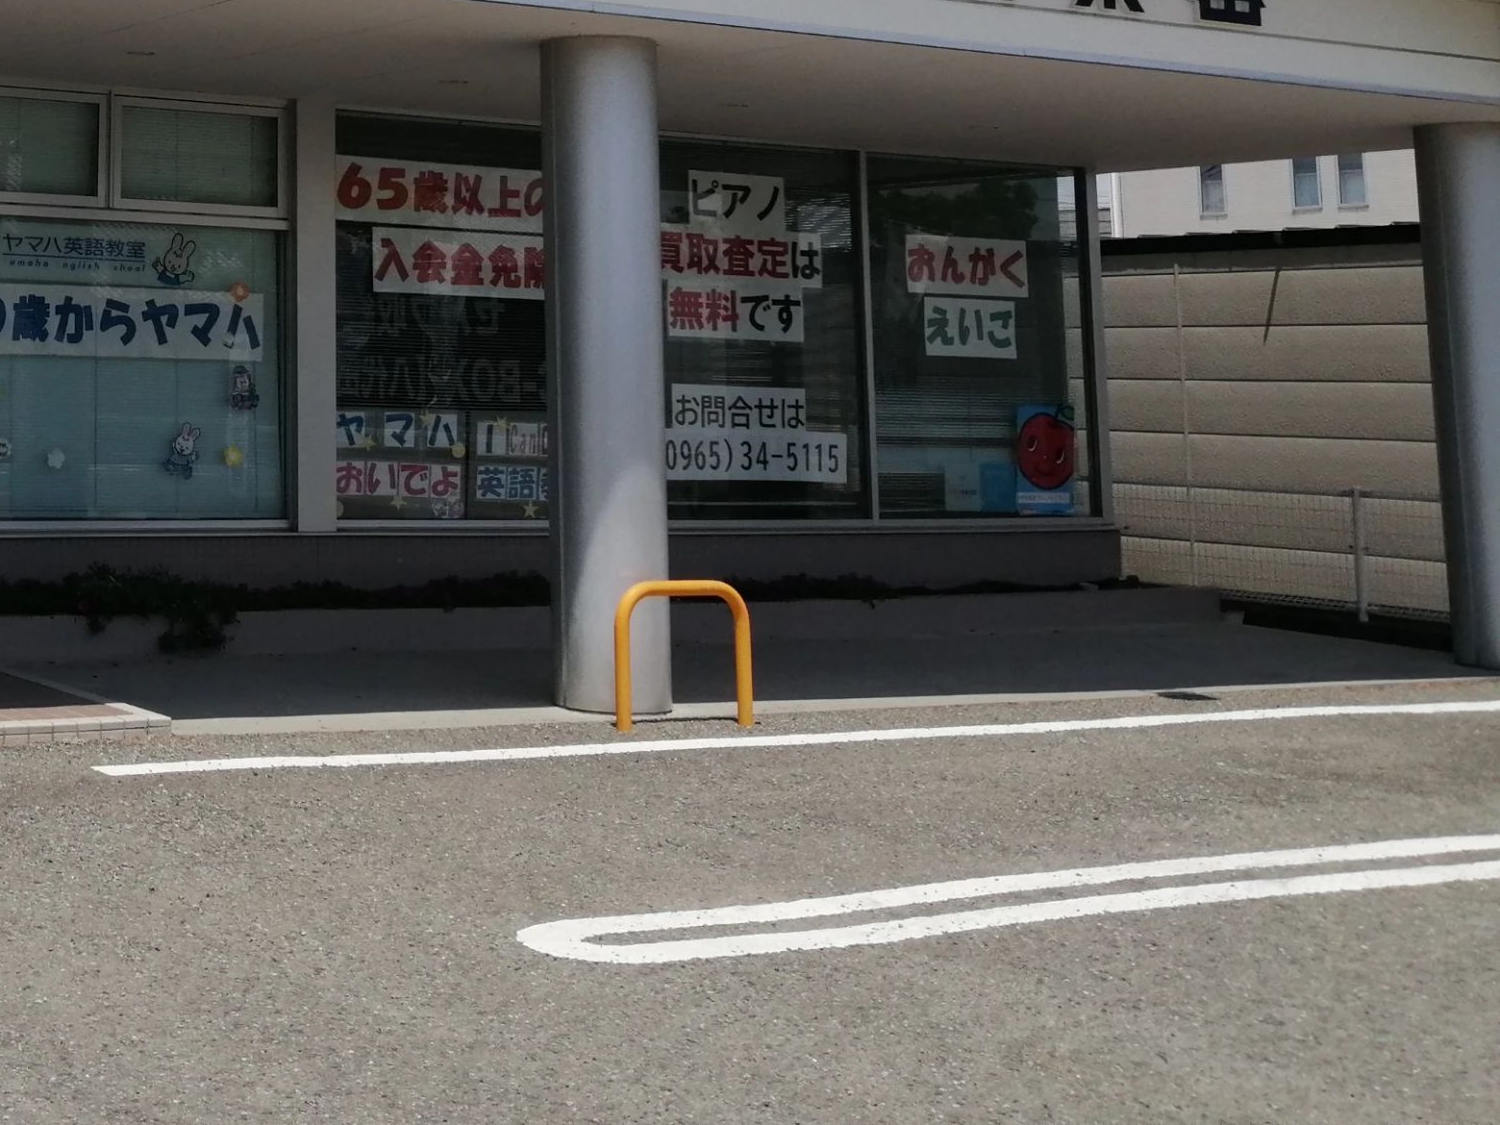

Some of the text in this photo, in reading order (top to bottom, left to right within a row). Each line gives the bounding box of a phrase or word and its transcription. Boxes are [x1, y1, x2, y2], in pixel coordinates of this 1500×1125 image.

[691, 179, 780, 221] ピアノ
[2, 233, 146, 259] ヤマハ英語教室
[660, 232, 821, 279] 買取査定は
[907, 244, 1026, 288] おんがく
[668, 287, 801, 333] 無料です
[336, 412, 456, 447] ヤマハ
[674, 396, 805, 430] お問合せは
[336, 462, 459, 495] おいでよ
